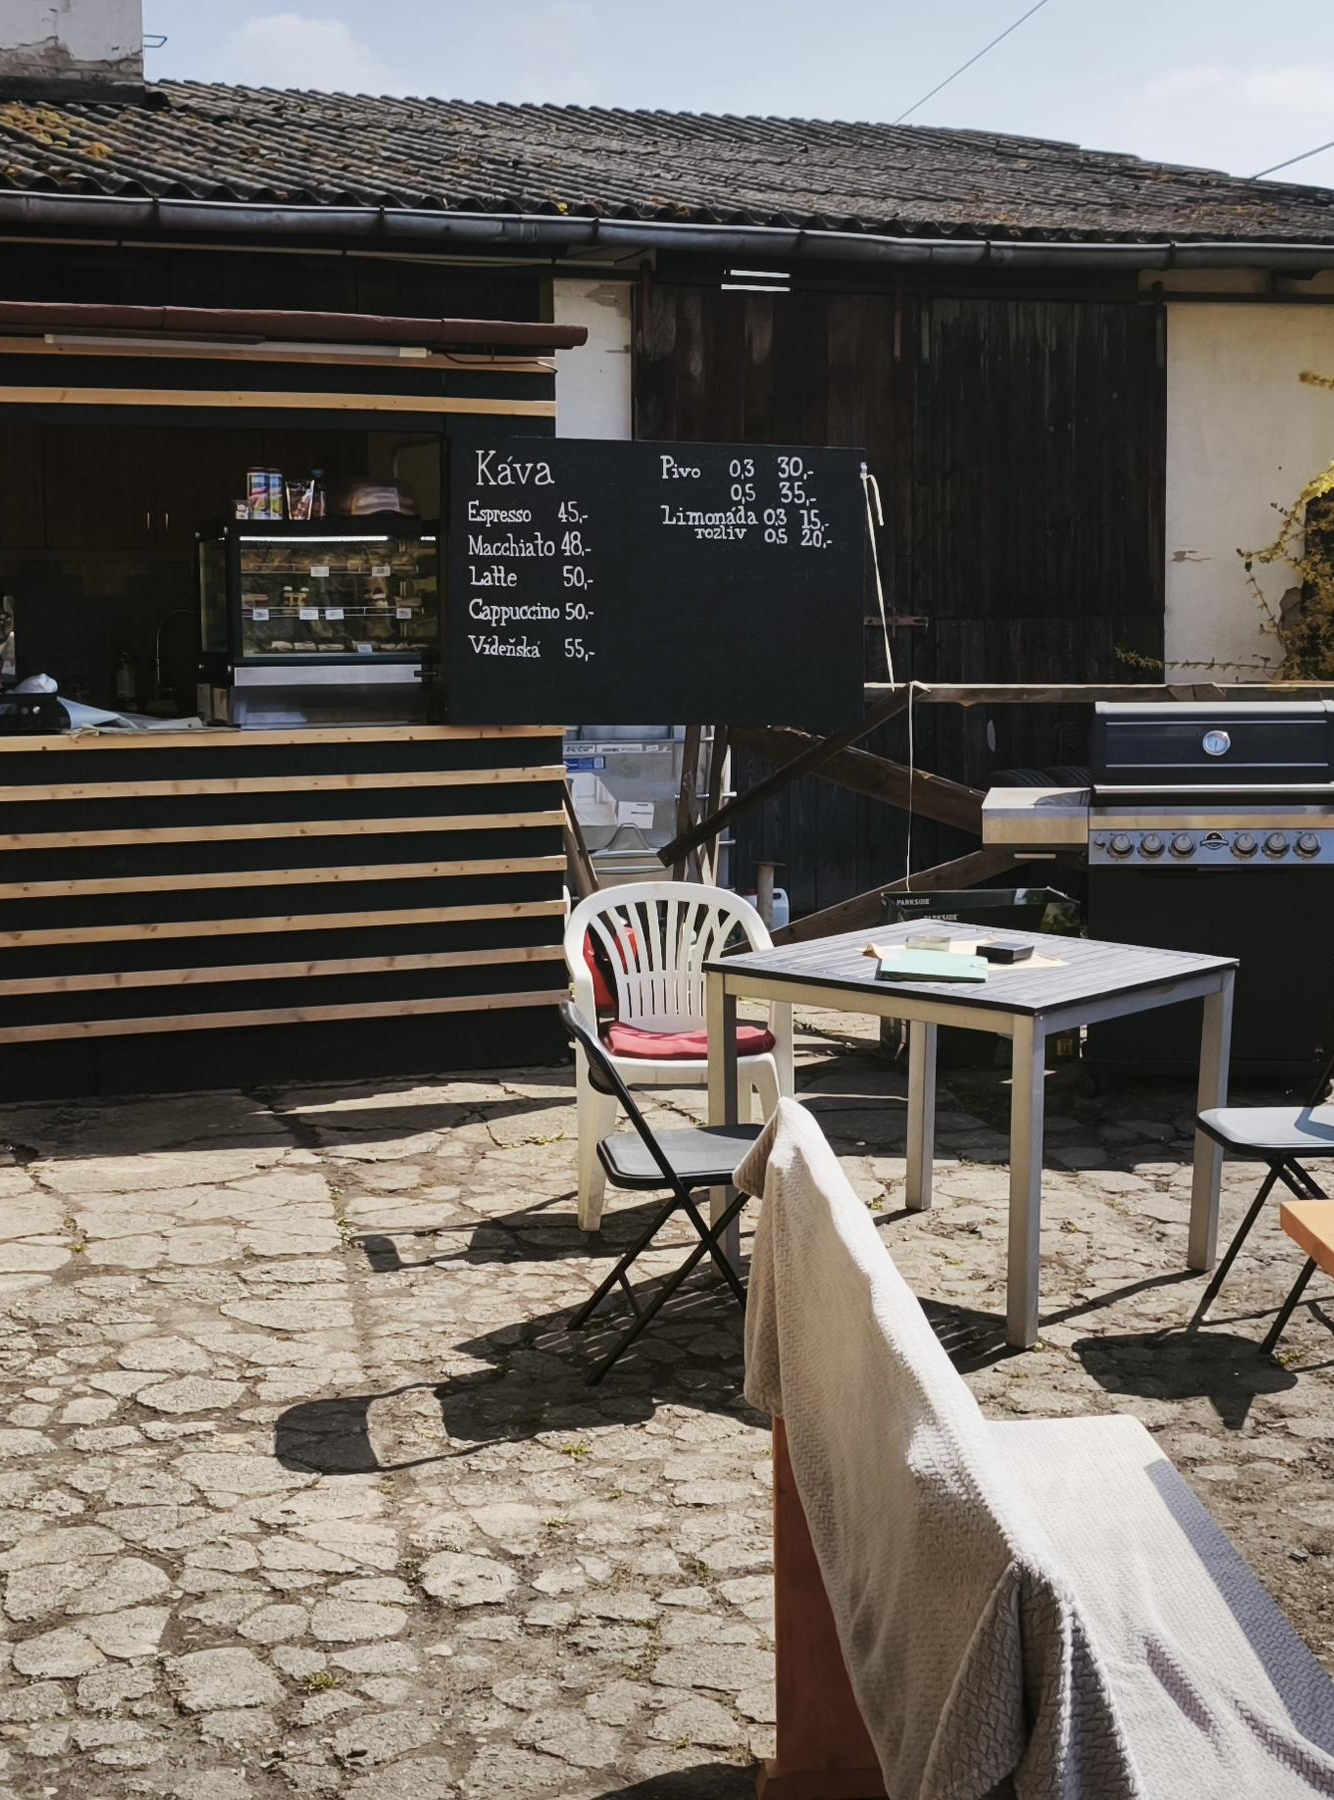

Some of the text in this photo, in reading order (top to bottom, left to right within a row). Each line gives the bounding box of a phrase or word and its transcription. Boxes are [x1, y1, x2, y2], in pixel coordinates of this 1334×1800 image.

[475, 449, 555, 486] Káva
[659, 455, 814, 480] Pivo 0,3 30,-
[730, 481, 817, 507] 0,5 35,-
[468, 500, 589, 527] Espresso 45,-
[660, 504, 759, 526] Limonáda
[467, 531, 556, 557] Macchiato
[694, 525, 747, 540] rozliv
[800, 529, 833, 549] 20,-
[468, 565, 594, 591] Latte 50,-
[468, 598, 560, 627] Cappuccino
[467, 634, 596, 662] Vídeňská 55,-
